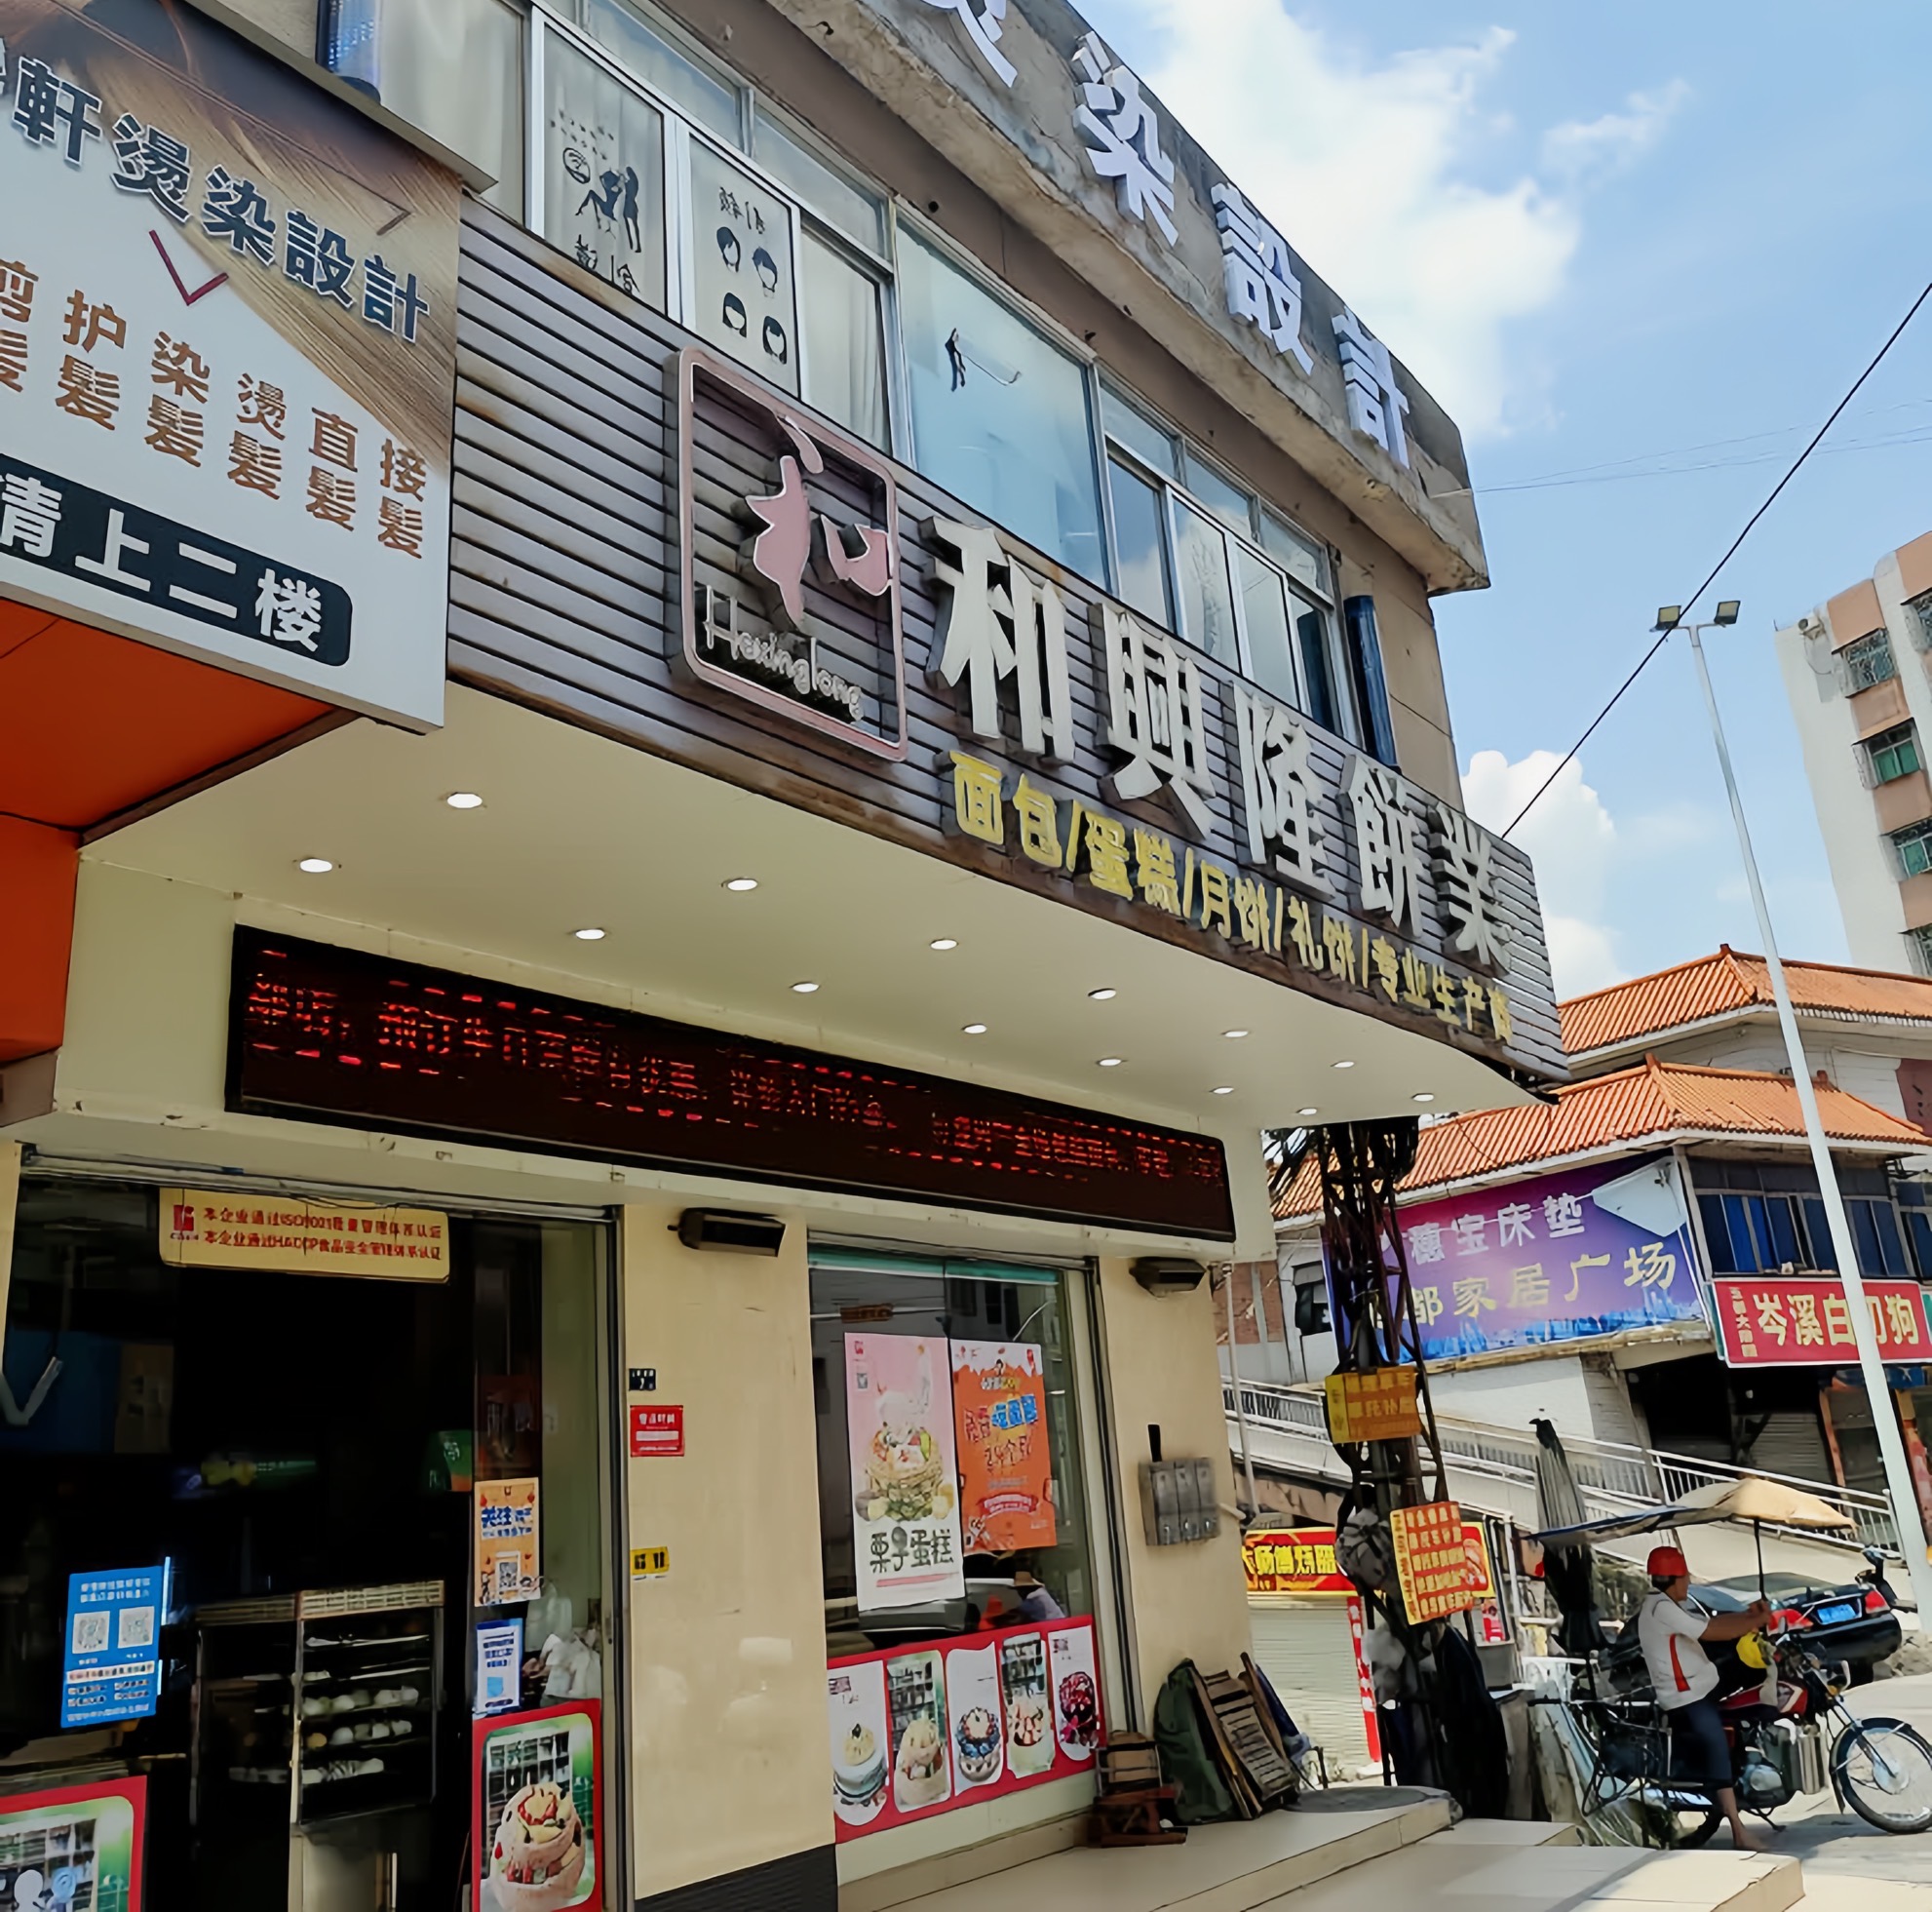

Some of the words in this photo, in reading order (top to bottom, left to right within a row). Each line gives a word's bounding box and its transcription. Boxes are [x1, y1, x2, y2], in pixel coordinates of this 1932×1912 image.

[0, 39, 430, 345] 軒燙染設計
[1369, 1241, 1677, 1328] 都家居广场
